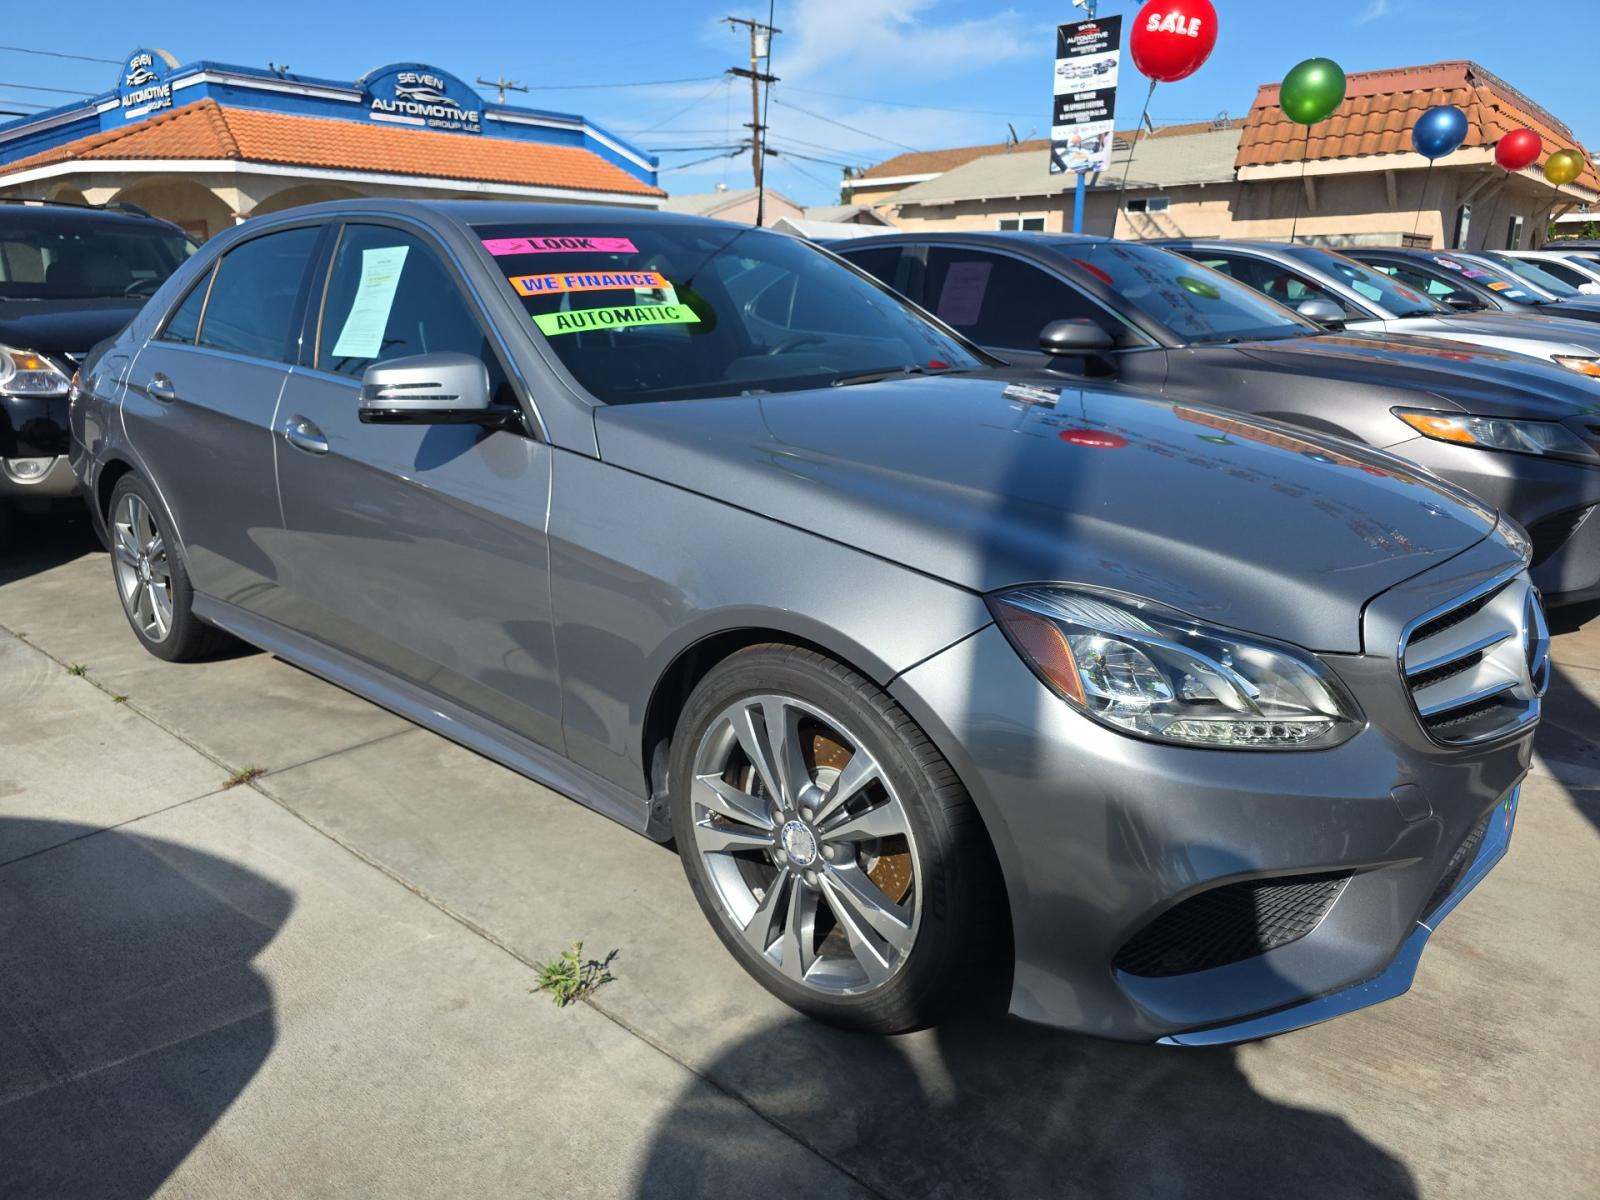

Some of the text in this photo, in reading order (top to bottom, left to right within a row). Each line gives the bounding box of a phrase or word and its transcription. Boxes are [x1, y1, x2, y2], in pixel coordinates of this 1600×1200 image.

[1146, 12, 1201, 37] SALE
[1067, 31, 1109, 44] AUTOMOTIVE
[130, 54, 152, 70] SEVEN
[397, 72, 444, 89] SEVEN
[122, 83, 170, 107] AUTOMOTIVE
[371, 98, 479, 122] AUTOMOTIVE
[427, 119, 481, 132] GROUP LLC
[527, 237, 597, 250] LOOK
[521, 273, 658, 292] WE FINANCE
[557, 306, 680, 330] AUTOMATIC
